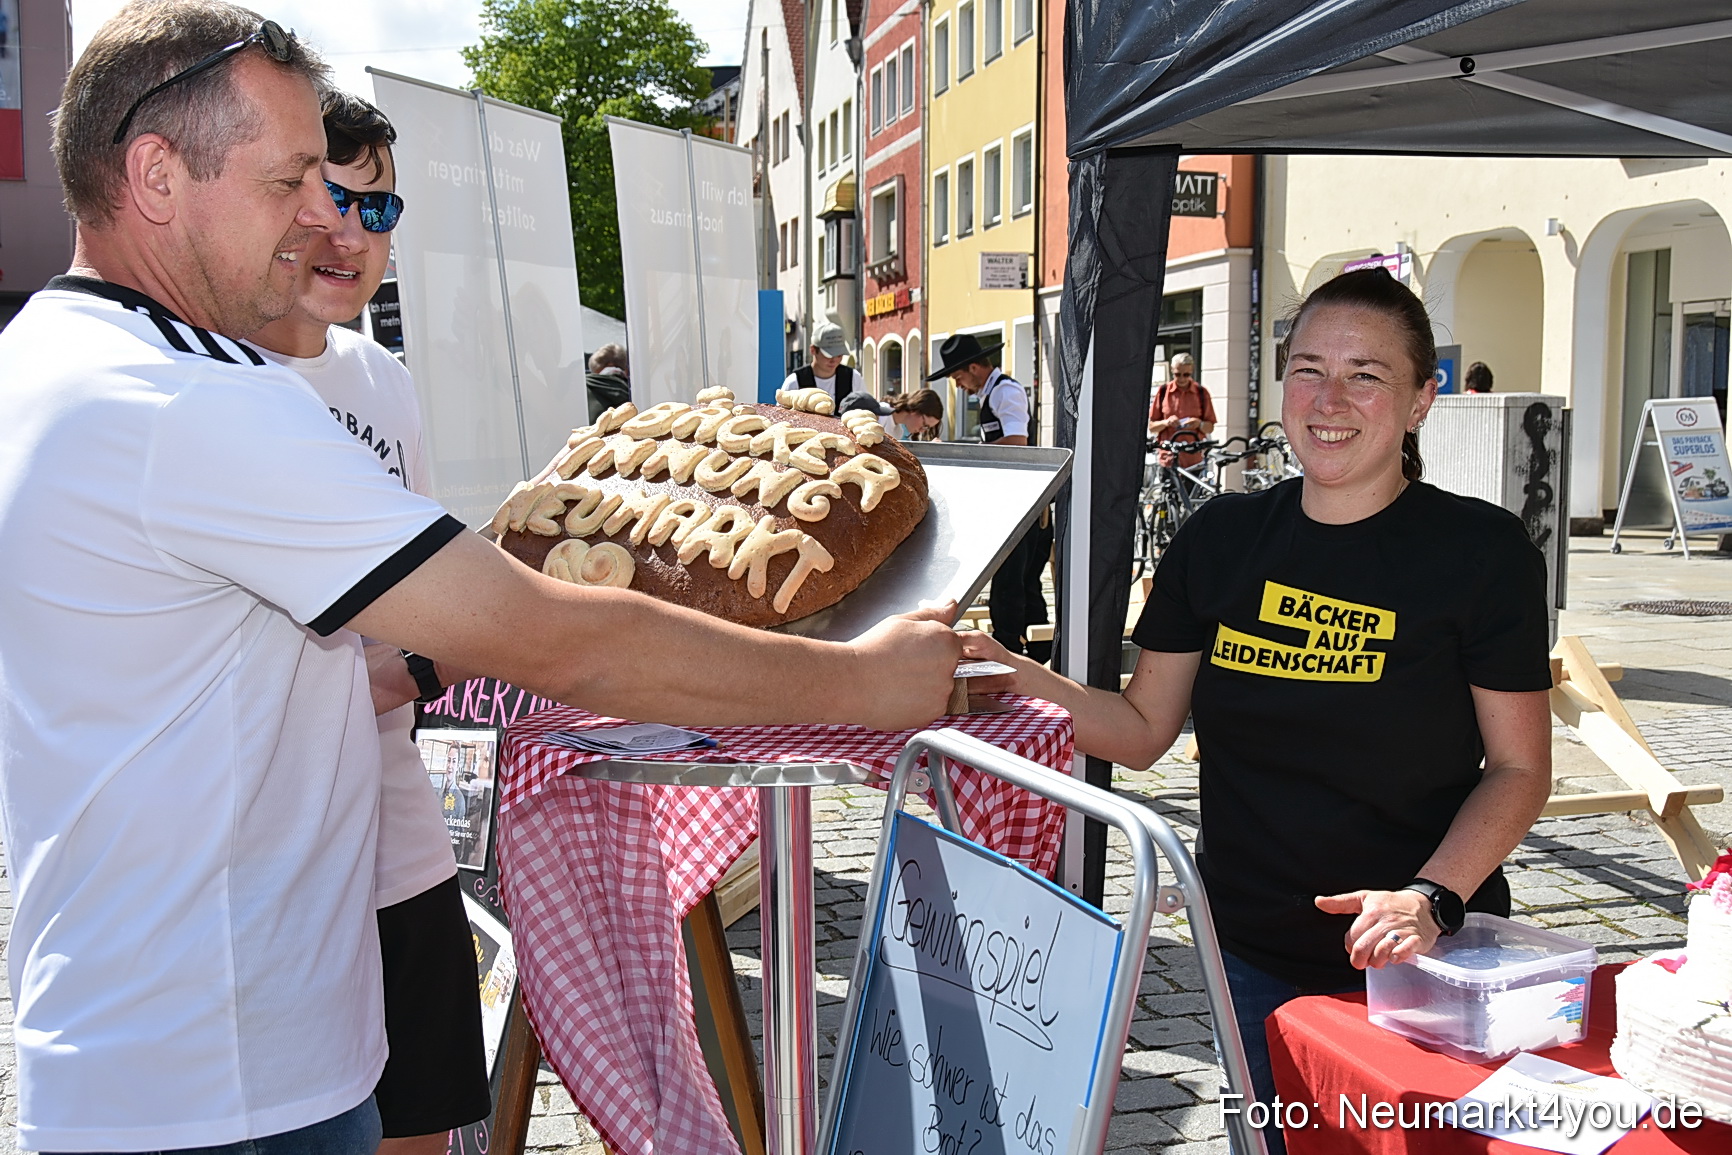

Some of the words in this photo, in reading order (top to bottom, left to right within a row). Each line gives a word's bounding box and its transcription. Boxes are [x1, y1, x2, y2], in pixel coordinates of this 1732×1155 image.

[1172, 197, 1206, 214] optik
[1673, 443, 1716, 456] SUPERLOS
[556, 434, 842, 522] INNUNG
[492, 481, 835, 614] NEUMARKT
[1277, 594, 1381, 634] BÄCKER
[1213, 637, 1377, 674] LEIDENSCHAFT
[1314, 630, 1360, 652] AUS
[891, 859, 1063, 1026] Gewinnspiel
[870, 1008, 903, 1067] Wie
[980, 1072, 1009, 1127] ist
[1015, 1095, 1056, 1155] das
